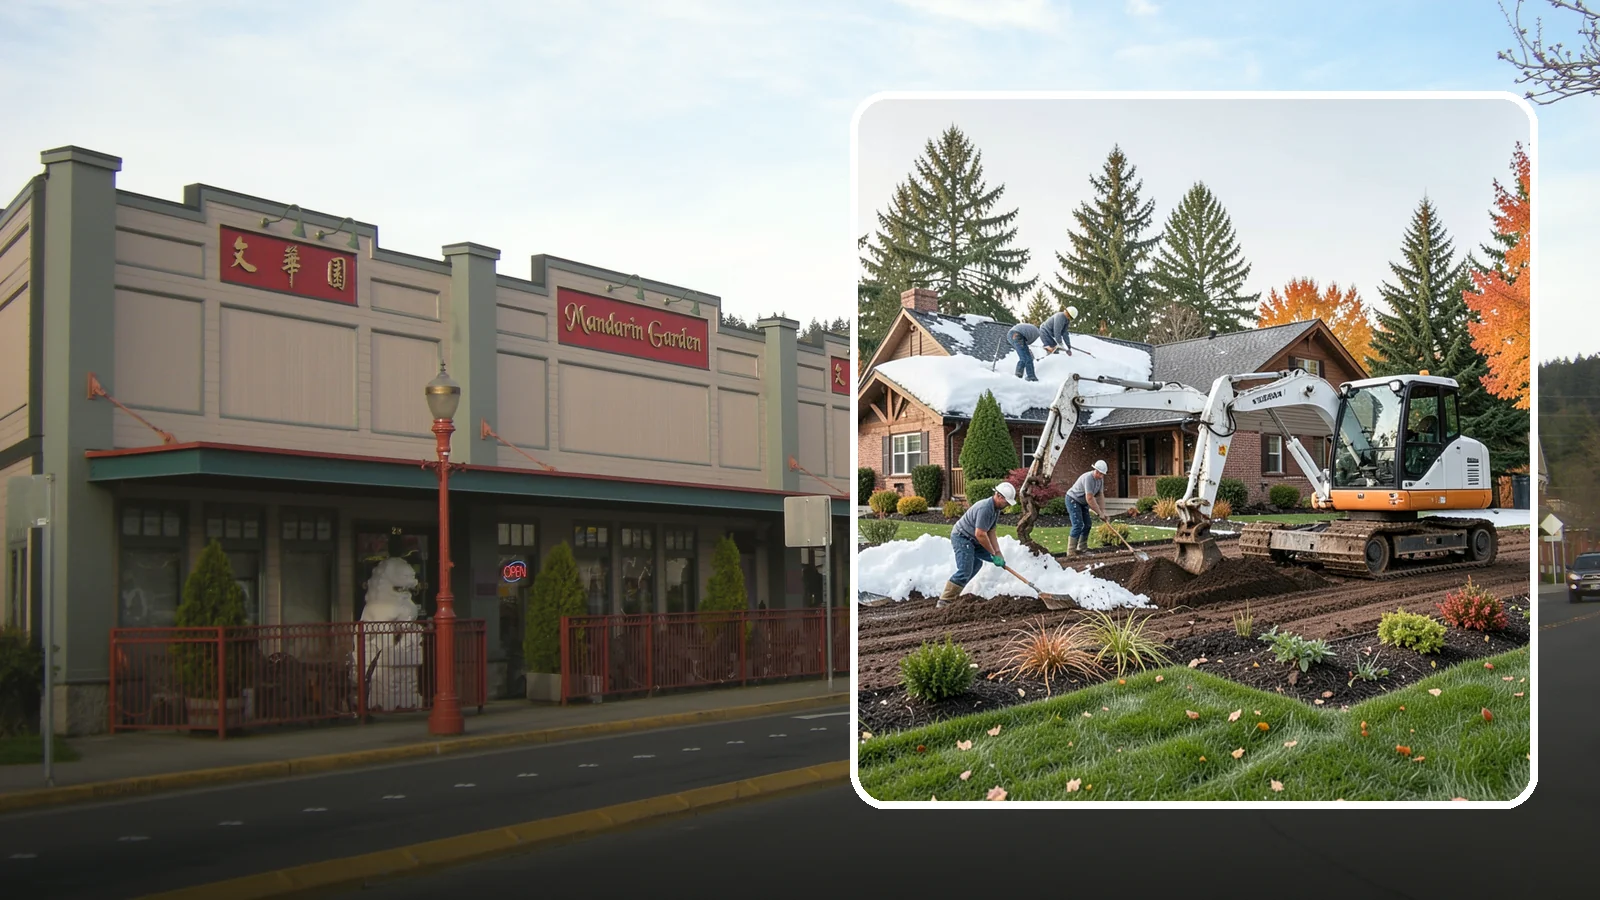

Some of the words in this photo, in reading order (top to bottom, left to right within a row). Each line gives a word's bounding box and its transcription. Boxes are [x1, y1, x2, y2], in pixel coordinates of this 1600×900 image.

[231, 236, 346, 290] 文華園
[564, 302, 643, 341] Mandarin
[648, 320, 702, 352] Garden
[503, 565, 526, 578] OPEN
